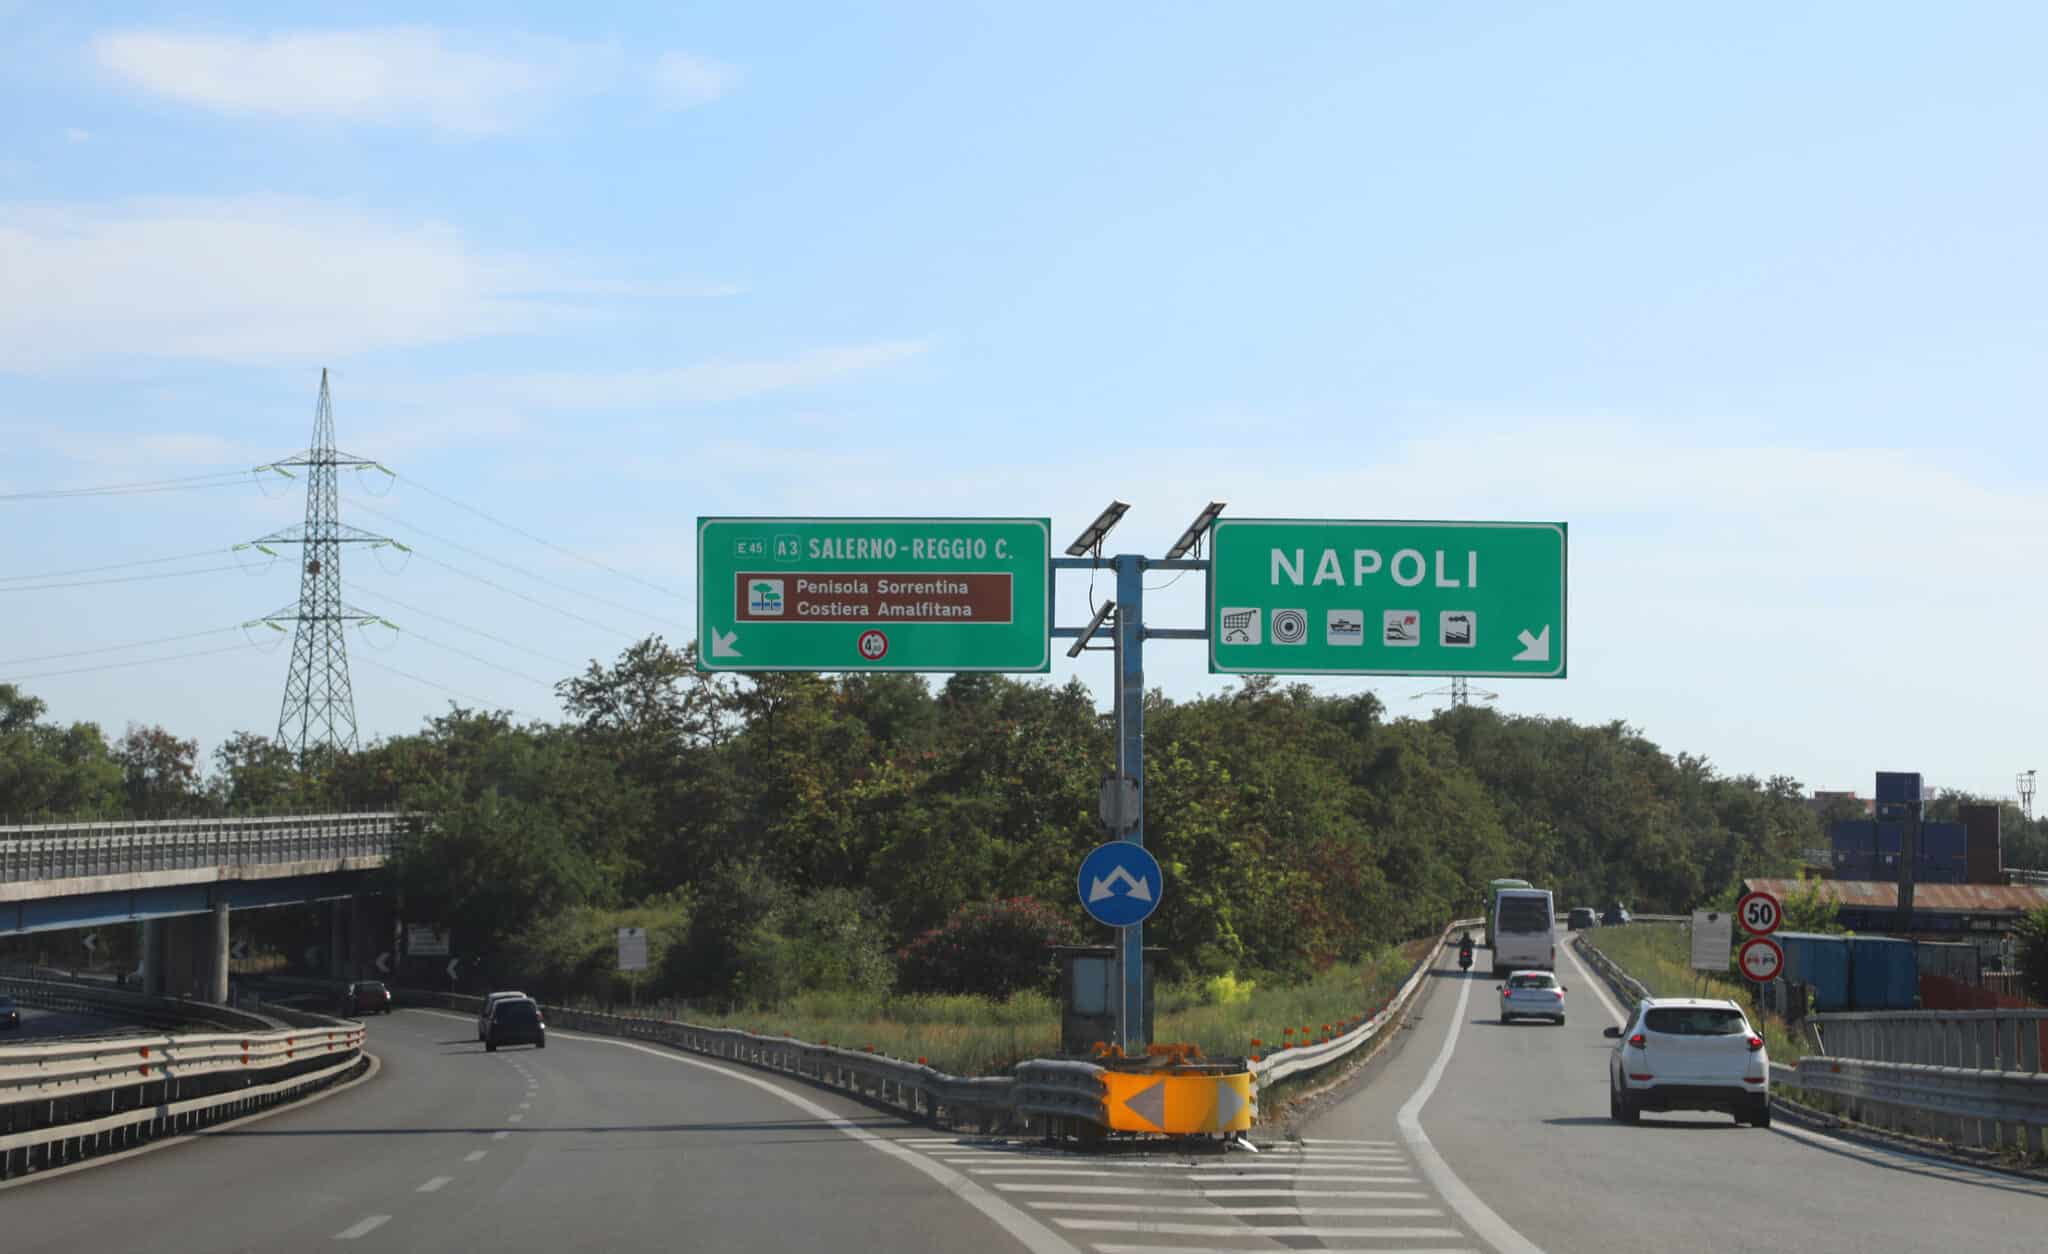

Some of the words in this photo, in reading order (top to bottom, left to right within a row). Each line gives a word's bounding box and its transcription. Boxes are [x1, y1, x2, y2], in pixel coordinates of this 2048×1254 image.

[994, 538, 1014, 560] C.
[1270, 548, 1478, 588] NAPOLI
[796, 579, 869, 594] Penisola
[877, 579, 969, 594] Sorrentina
[796, 601, 870, 616] Costiera
[877, 601, 972, 617] Amalfitana
[1747, 902, 1773, 925] 50
